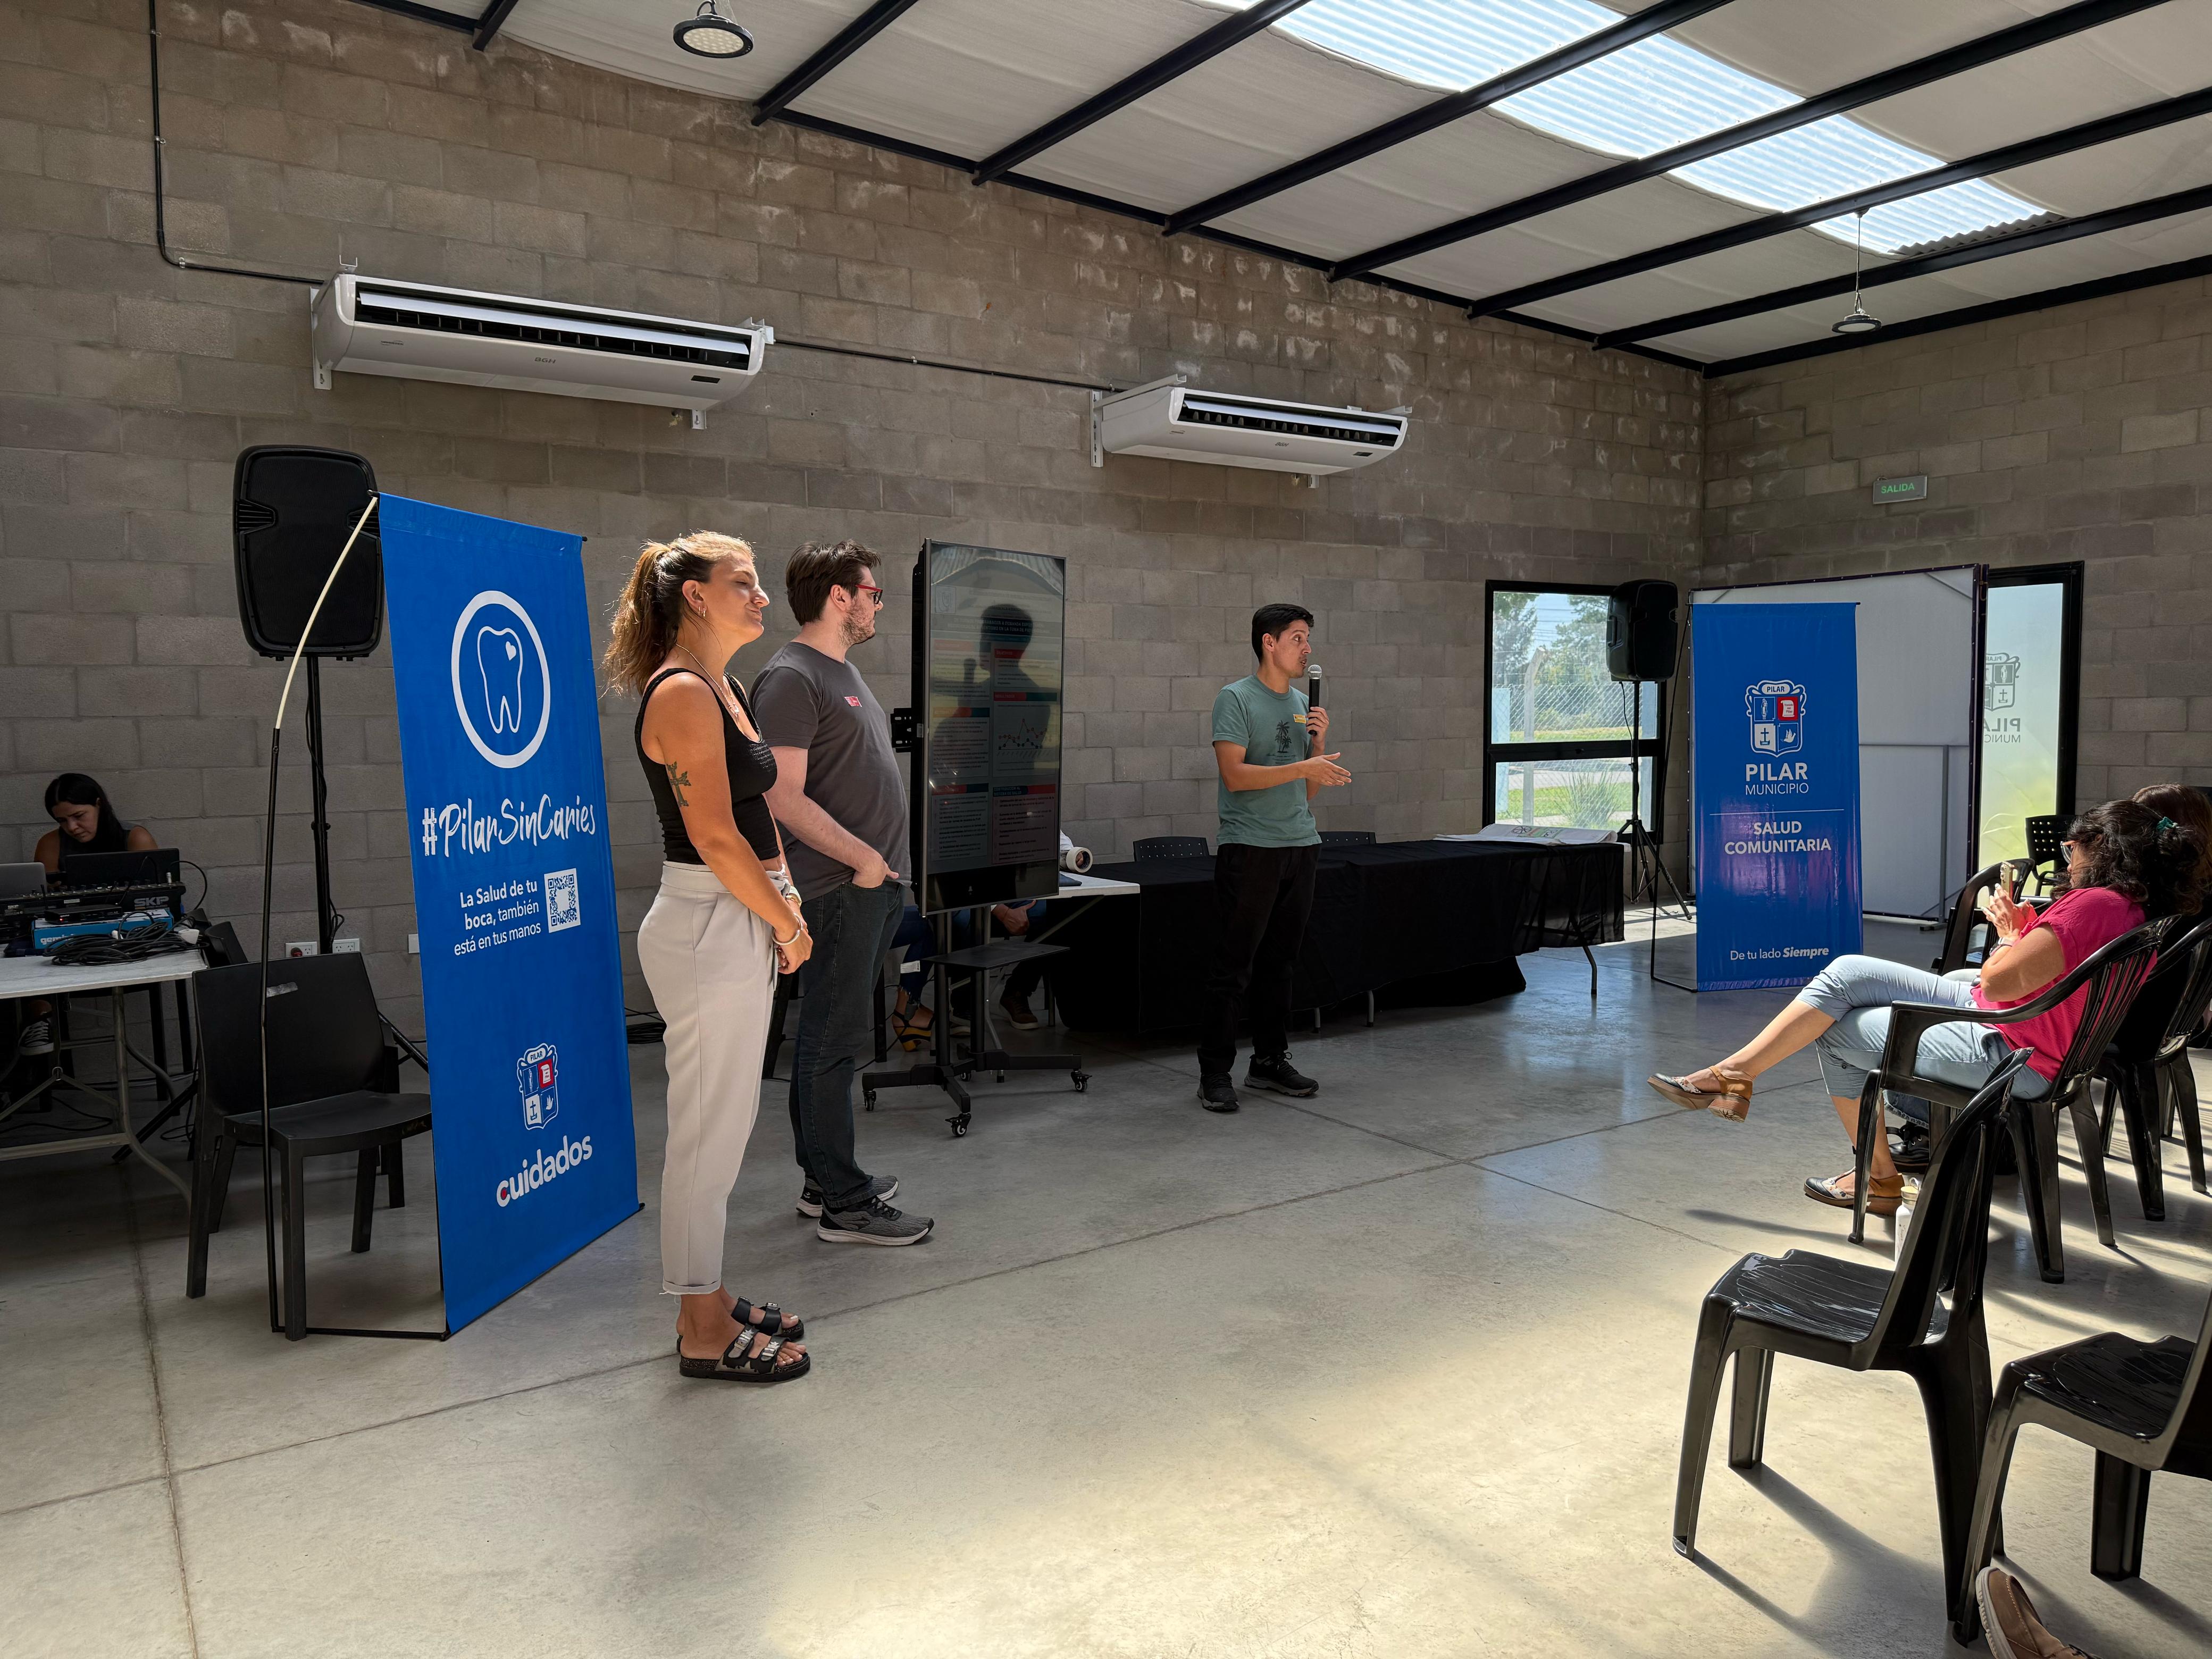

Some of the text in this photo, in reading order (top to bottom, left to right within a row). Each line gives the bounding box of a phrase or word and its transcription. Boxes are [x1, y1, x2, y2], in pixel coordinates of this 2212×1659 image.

[1881, 483, 1914, 493] SALIDA
[1746, 763, 1808, 782] PILAR
[1745, 782, 1809, 795] MUNICIPIO
[422, 793, 596, 858] #PilarSinCaries
[1754, 820, 1802, 835] SALUD
[1724, 838, 1831, 855] COMUNITARIA
[133, 895, 170, 907] SKP
[460, 879, 538, 908] La Salud de tu
[465, 900, 539, 931] boca, también
[454, 923, 541, 956] está en tus manos
[1730, 946, 1829, 960] De tu lado Siempre
[530, 1051, 543, 1061] PILAR
[496, 1135, 592, 1208] cuidados
